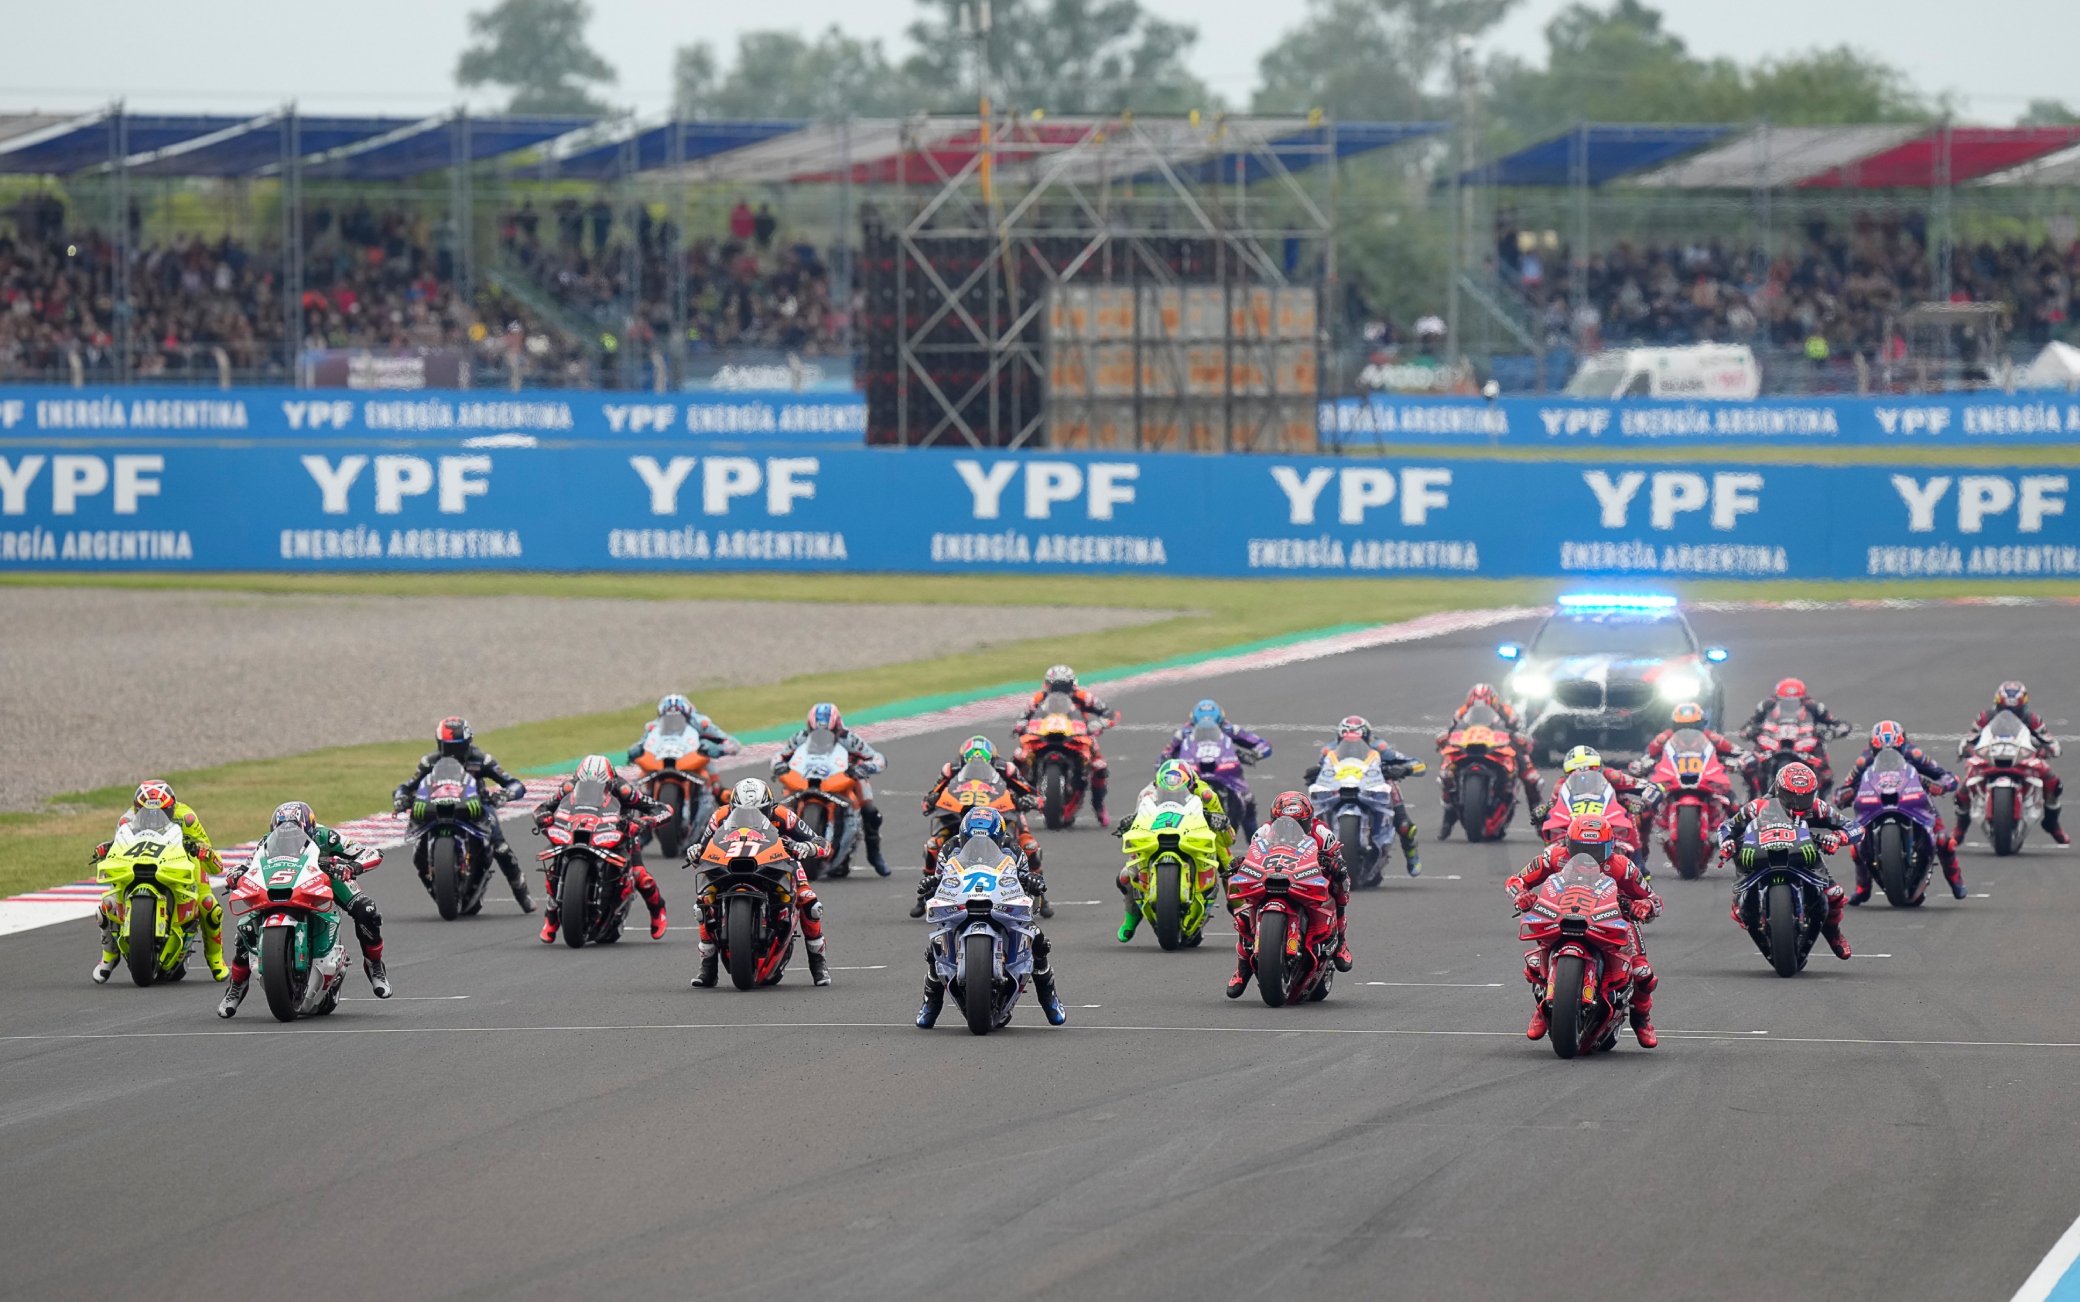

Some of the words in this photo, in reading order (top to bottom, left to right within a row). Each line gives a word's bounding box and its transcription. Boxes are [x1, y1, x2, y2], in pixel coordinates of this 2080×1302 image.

[130, 400, 247, 428] ARGENTINA
[283, 401, 353, 428] YPF
[603, 404, 675, 432] YPF
[1540, 408, 1611, 436] YPF
[1875, 406, 1951, 435] YPF
[0, 455, 164, 514] YPF
[302, 454, 493, 514] YPF
[629, 455, 820, 515] YPF
[954, 460, 1140, 520] YPF
[1270, 466, 1453, 526] YPF
[1582, 470, 1765, 530] YPF
[1891, 474, 2070, 533] YPF
[0, 525, 56, 560] RGÍA
[62, 531, 193, 560] ARGENTINA
[281, 525, 382, 559] ENERGÍA
[387, 529, 522, 560] ARGENTINA
[715, 530, 848, 560] ARGENTINA
[1034, 534, 1167, 564] ARGENTINA
[1678, 757, 1704, 775] 10
[959, 791, 991, 807] 33
[1569, 801, 1605, 818] 36
[1150, 811, 1185, 831] 21
[122, 840, 167, 859] 49
[725, 841, 763, 858] 37
[1758, 828, 1797, 845] 20
[262, 862, 303, 871] CUSTOM
[1240, 864, 1262, 879] Lenovo
[1261, 853, 1301, 873] 63
[1293, 868, 1320, 880] Lenovo
[266, 868, 299, 886] 5
[961, 871, 998, 894] 73
[1534, 903, 1557, 919] Lenovo
[1557, 891, 1601, 916] 93
[1592, 909, 1619, 921] Lenovo
